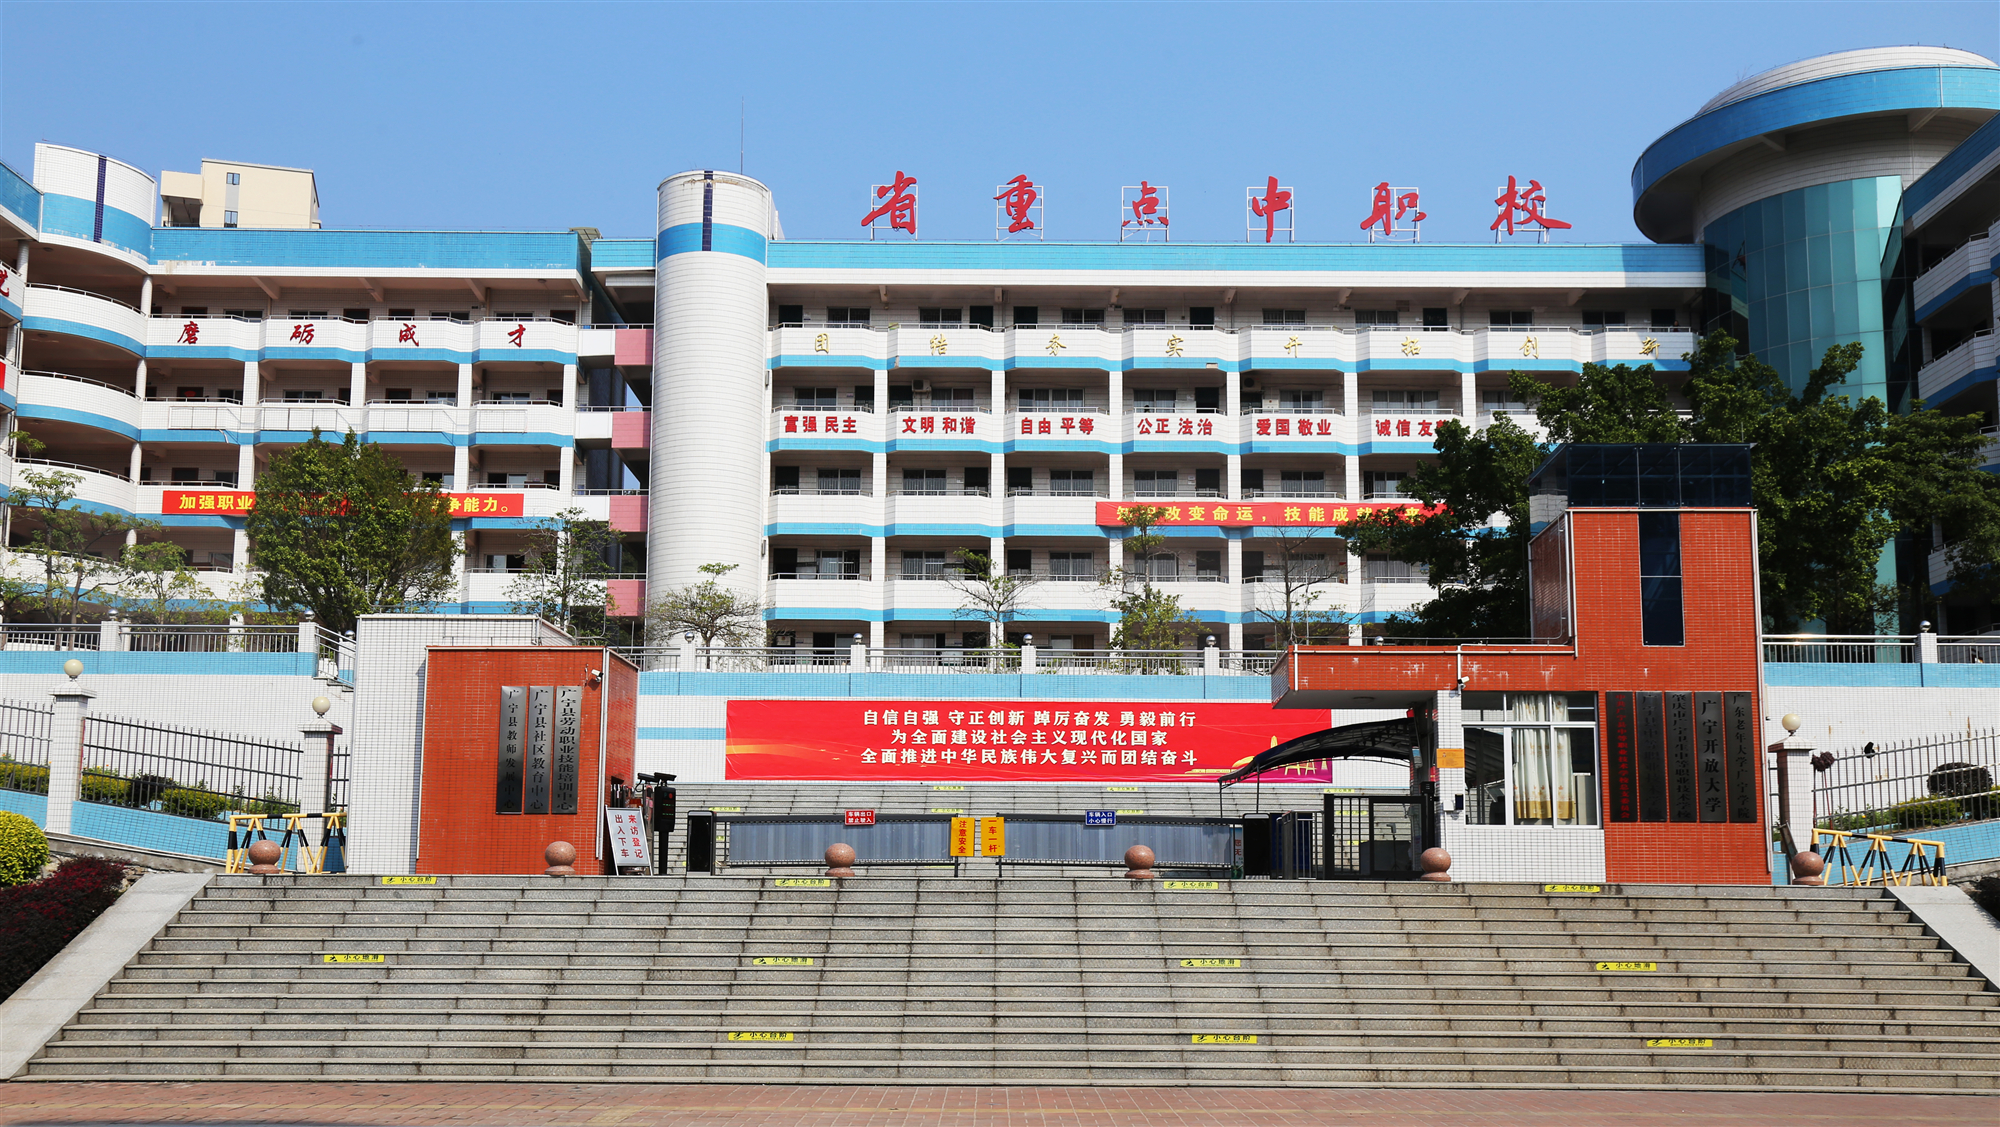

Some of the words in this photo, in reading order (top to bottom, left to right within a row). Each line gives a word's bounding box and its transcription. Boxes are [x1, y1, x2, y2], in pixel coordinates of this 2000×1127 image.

[861, 171, 1572, 243] 省重点中职校
[177, 321, 527, 347] 磨砺成才
[814, 333, 1661, 359] 团结务实开拓创新
[784, 415, 857, 433] 富强民主
[902, 416, 976, 434] 文明和谐
[1021, 417, 1094, 435] 自由平等
[1138, 418, 1213, 435] 公正法治
[1257, 418, 1331, 436] 爱国敬业
[179, 495, 252, 510] 加强职业
[863, 710, 939, 726] 自信自强
[949, 711, 1025, 726] 守正创新
[1034, 711, 1110, 727] 踔厉奋发
[1120, 711, 1196, 727] 勇毅前行
[504, 689, 519, 809] 广宁县教师发展中心
[530, 689, 549, 810] 广宁县社区教育中心
[556, 689, 577, 811] 广宁县劳动职业技能培训中心
[891, 730, 1168, 746] 为全面建设社会主义现代化国家
[861, 749, 1198, 766] 全面推进中华民族伟大复兴而团结奋斗
[1671, 694, 1692, 819] 肇庆市广宁卫生中等职业技术学校
[1701, 700, 1721, 813] 广宁开放大学
[1733, 693, 1751, 819] 广东老年大学广宁学院
[615, 814, 629, 857] 出入下车
[628, 814, 643, 858] 来访登记
[958, 820, 967, 854] 注意安全
[988, 819, 997, 852] 一车一杆
